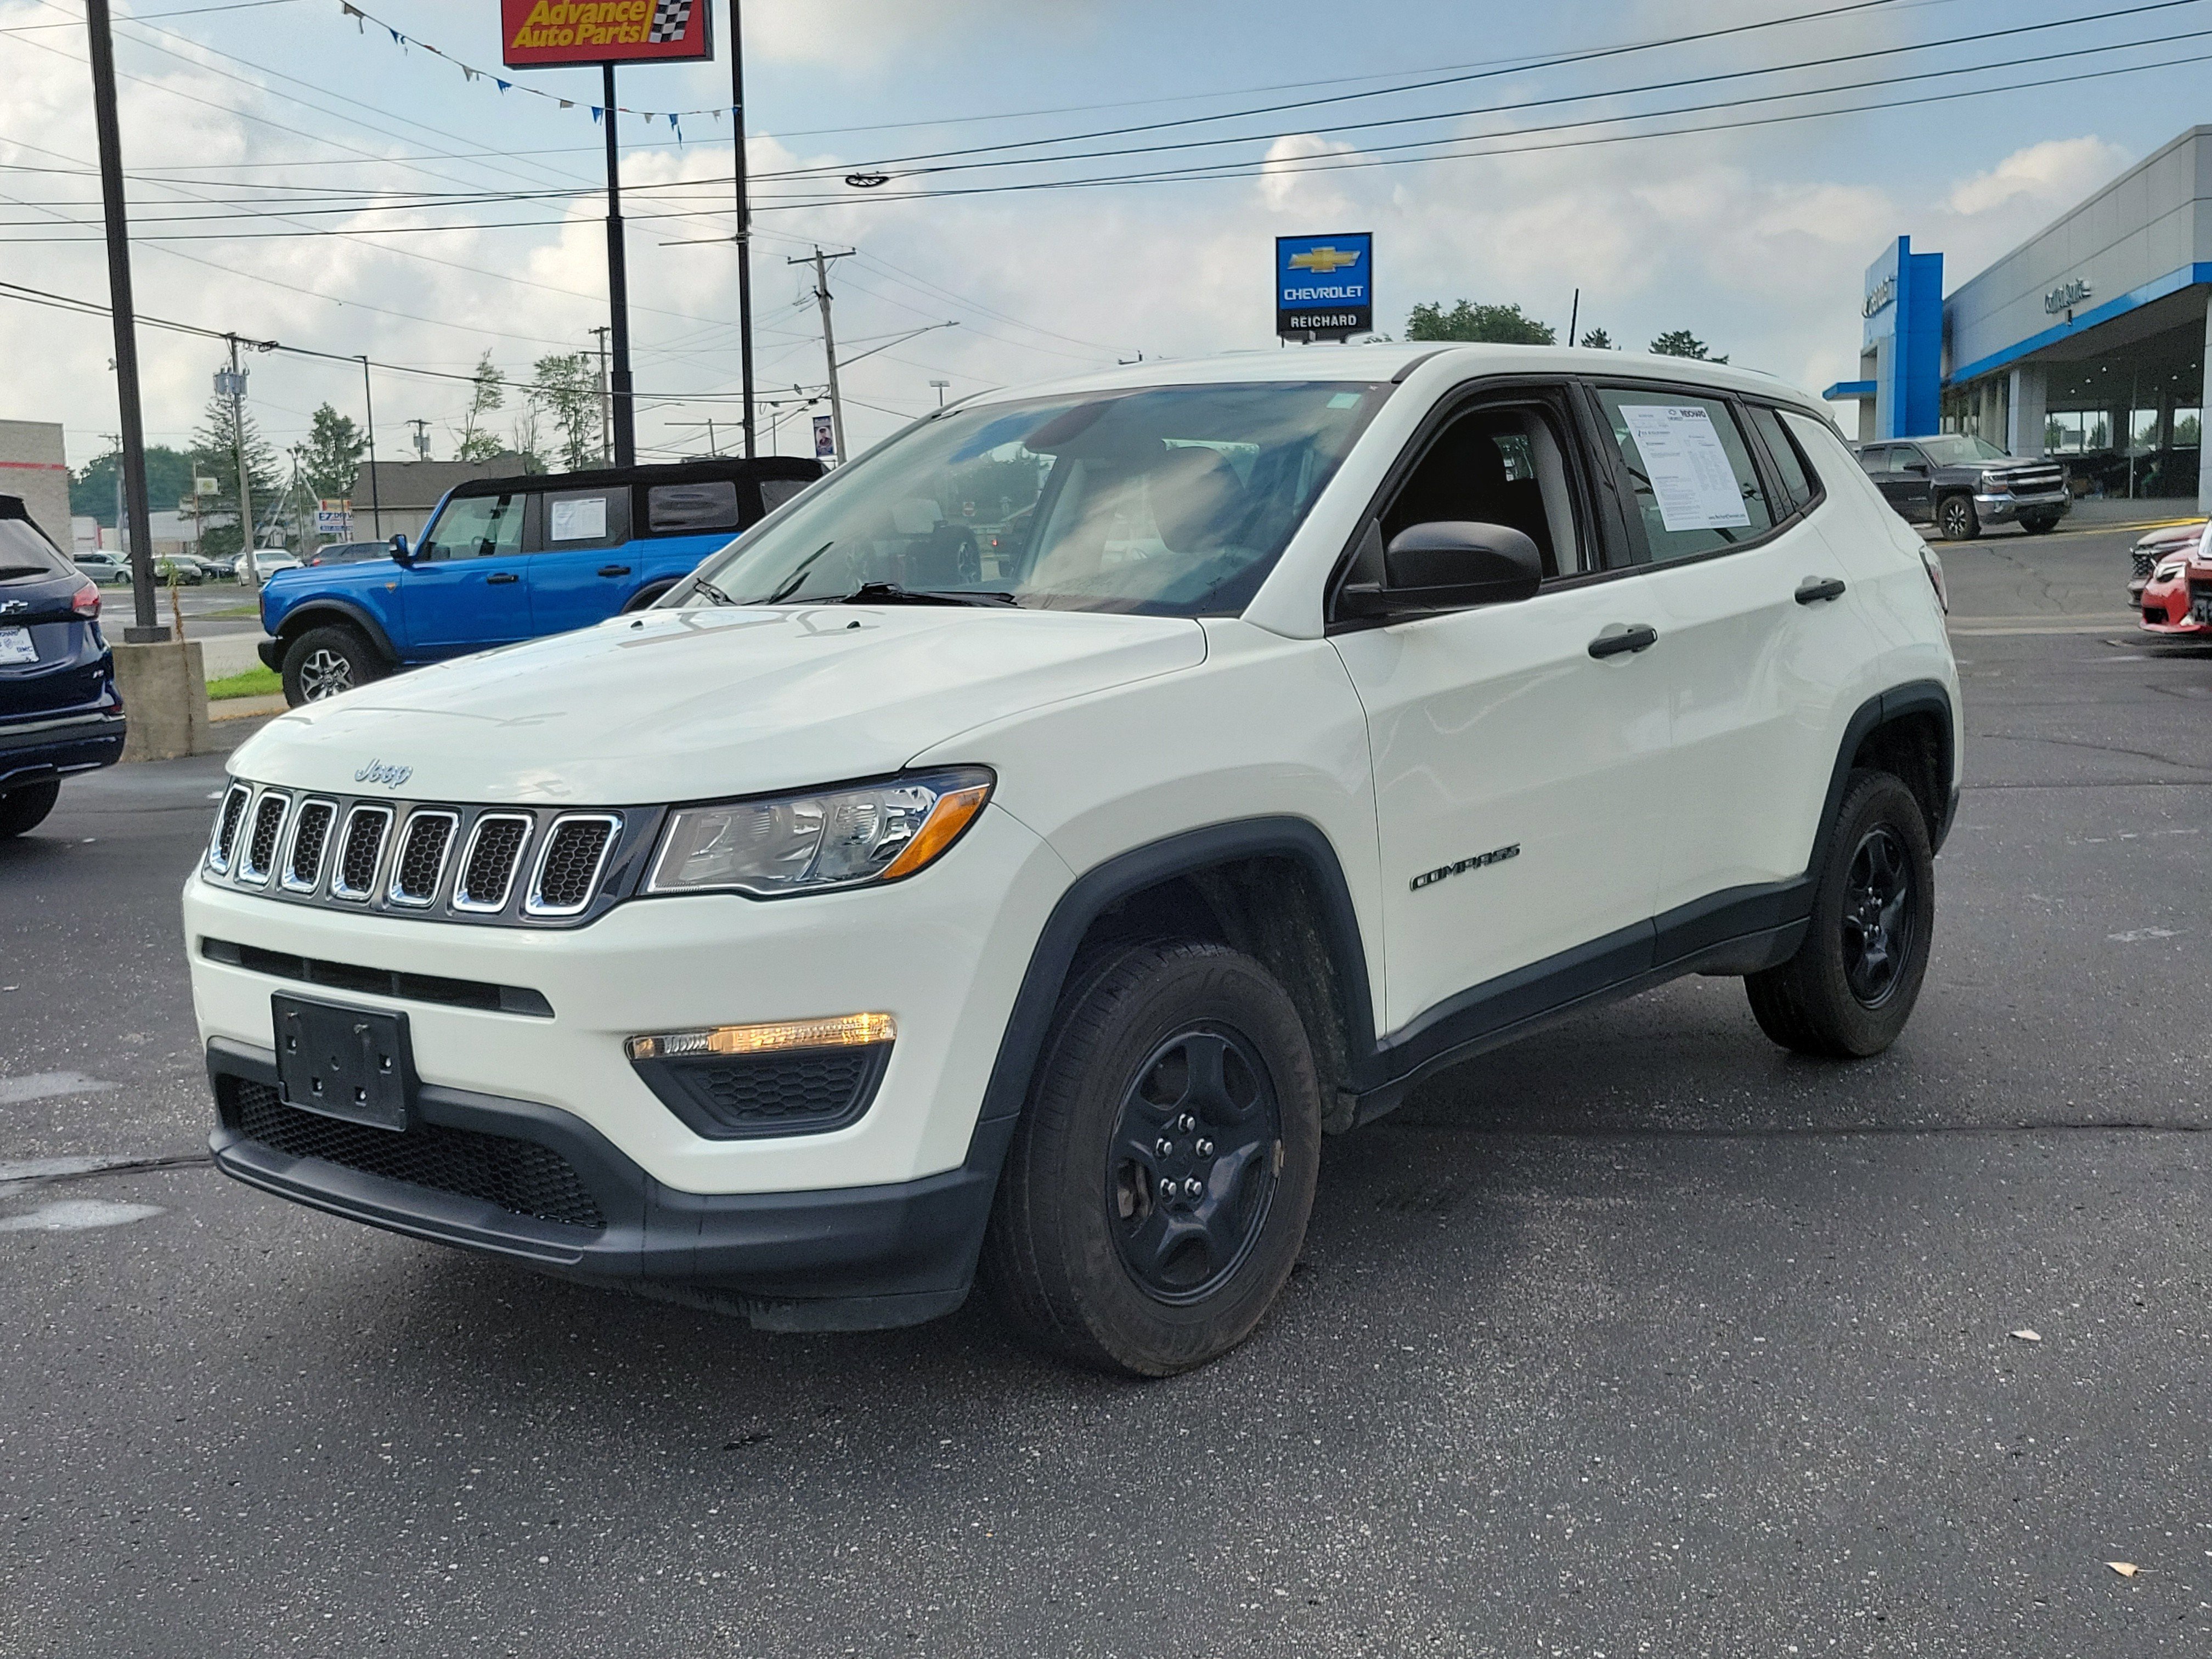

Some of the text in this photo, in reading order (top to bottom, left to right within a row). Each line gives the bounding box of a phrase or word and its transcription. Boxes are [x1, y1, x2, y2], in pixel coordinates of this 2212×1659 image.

[525, 0, 646, 27] Advance
[511, 22, 642, 48] Auto Parts
[1284, 286, 1364, 300] CHEVROLET
[1290, 314, 1357, 328] REICHARD
[355, 758, 413, 789] Jeep
[1410, 843, 1521, 891] COMPASS
